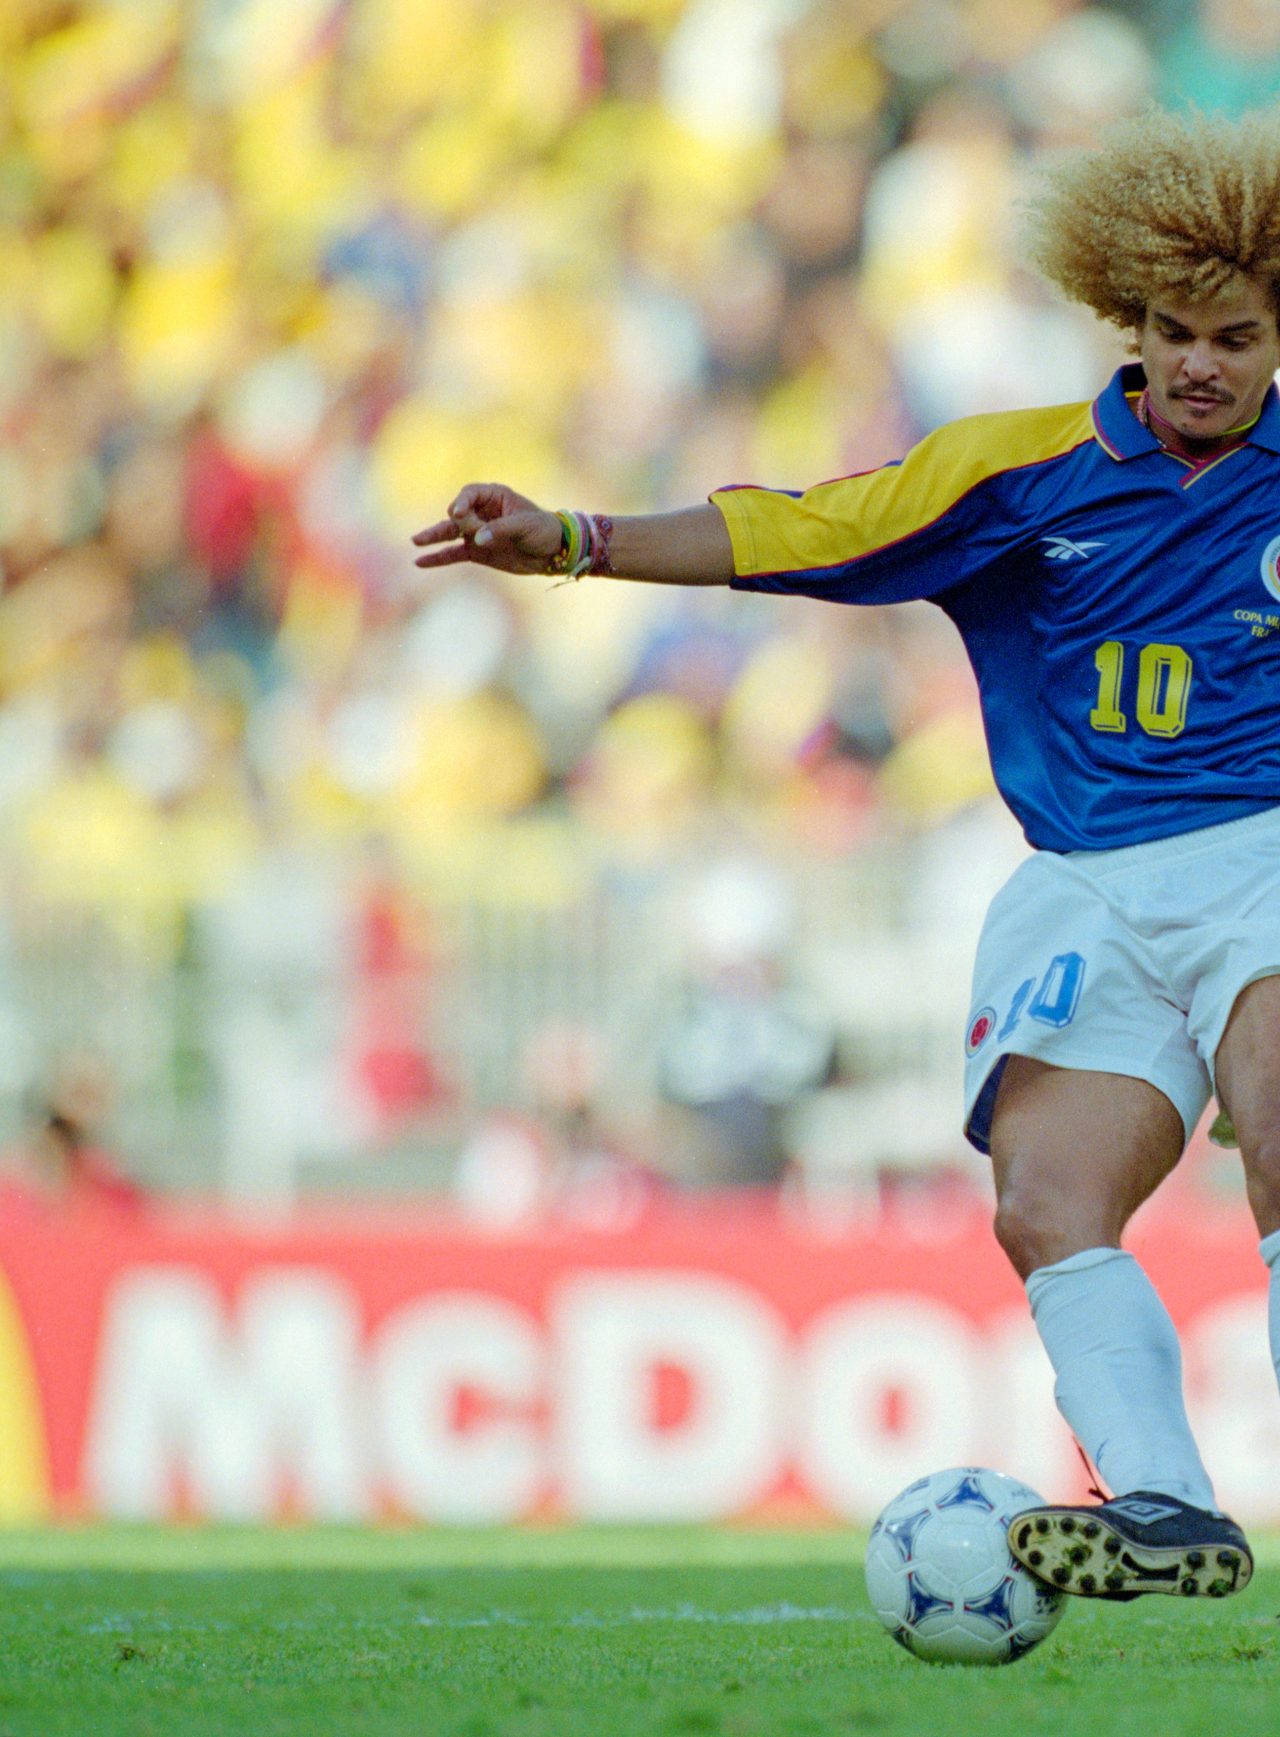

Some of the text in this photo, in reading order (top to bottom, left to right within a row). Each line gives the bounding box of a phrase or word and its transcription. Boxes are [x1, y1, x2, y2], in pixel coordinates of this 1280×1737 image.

[1234, 610, 1262, 624] COPA
[1090, 640, 1193, 739] 10
[997, 951, 1086, 1042] 10
